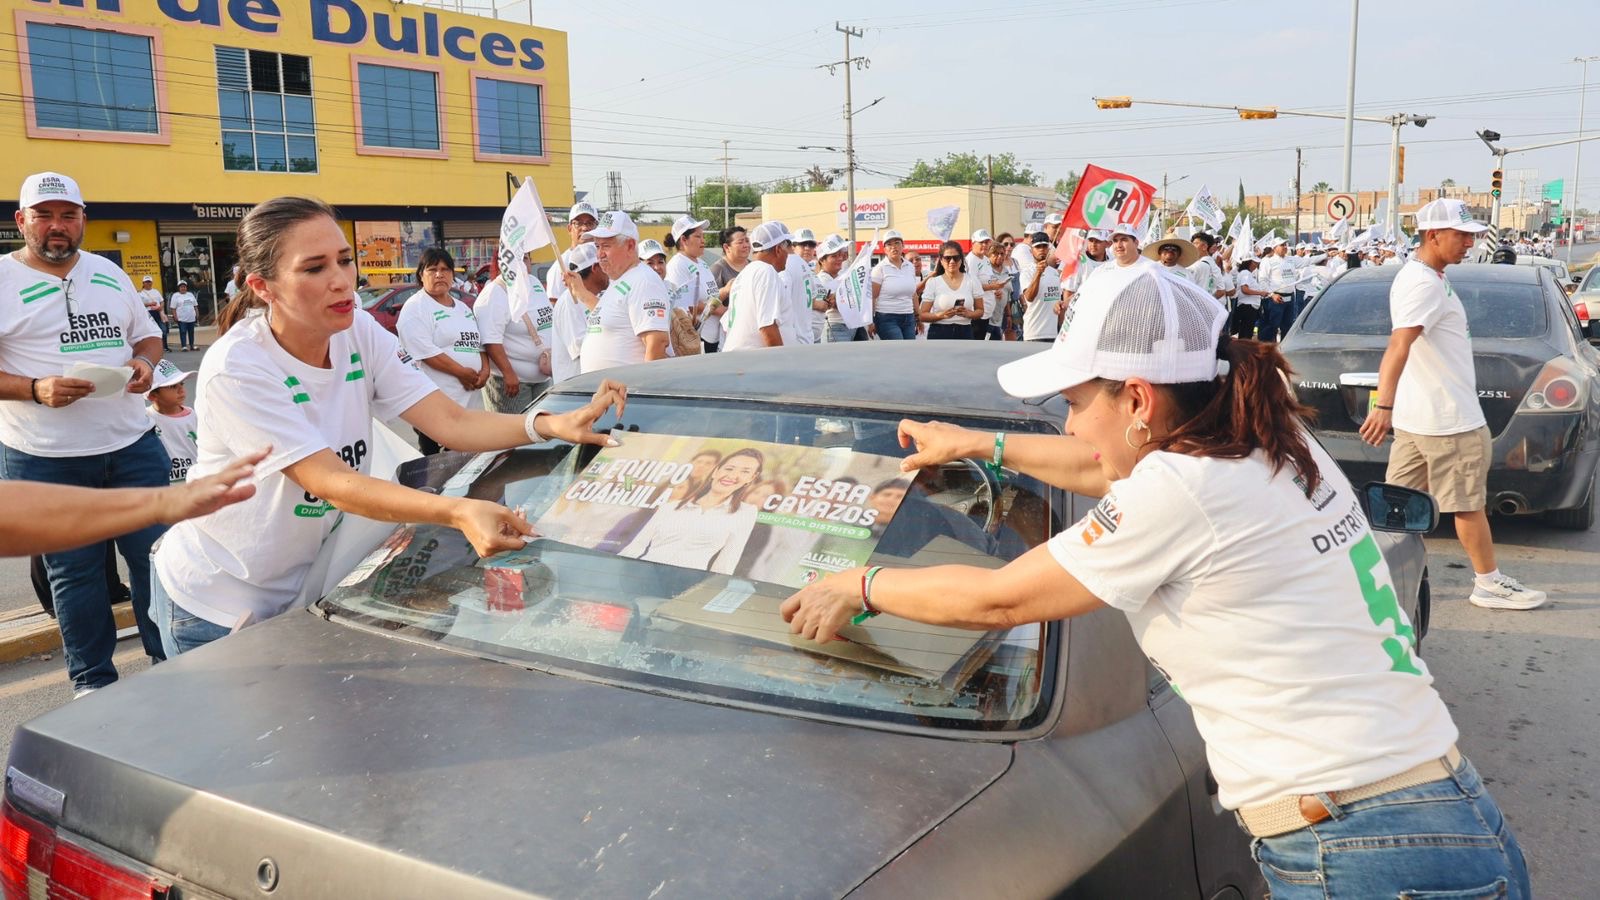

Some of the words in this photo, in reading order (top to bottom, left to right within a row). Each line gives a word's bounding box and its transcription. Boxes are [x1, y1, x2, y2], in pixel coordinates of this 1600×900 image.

[310, 0, 546, 70] Dulces
[197, 206, 254, 218] BIENVEN
[1088, 188, 1137, 223] PRI
[68, 312, 109, 329] ESRA
[60, 326, 121, 343] CAVAZOS
[1299, 381, 1337, 390] ALTIMA
[172, 458, 192, 468] SRA
[603, 459, 693, 485] EQUIPO
[565, 480, 673, 509] COAHUILA
[792, 475, 872, 504] ESRA
[763, 494, 879, 526] CAVAZOS
[758, 513, 806, 527] DIPUTADA
[808, 522, 855, 535] DISTRITO
[1311, 500, 1368, 554] DISTRIT
[801, 552, 857, 568] ALIANZA
